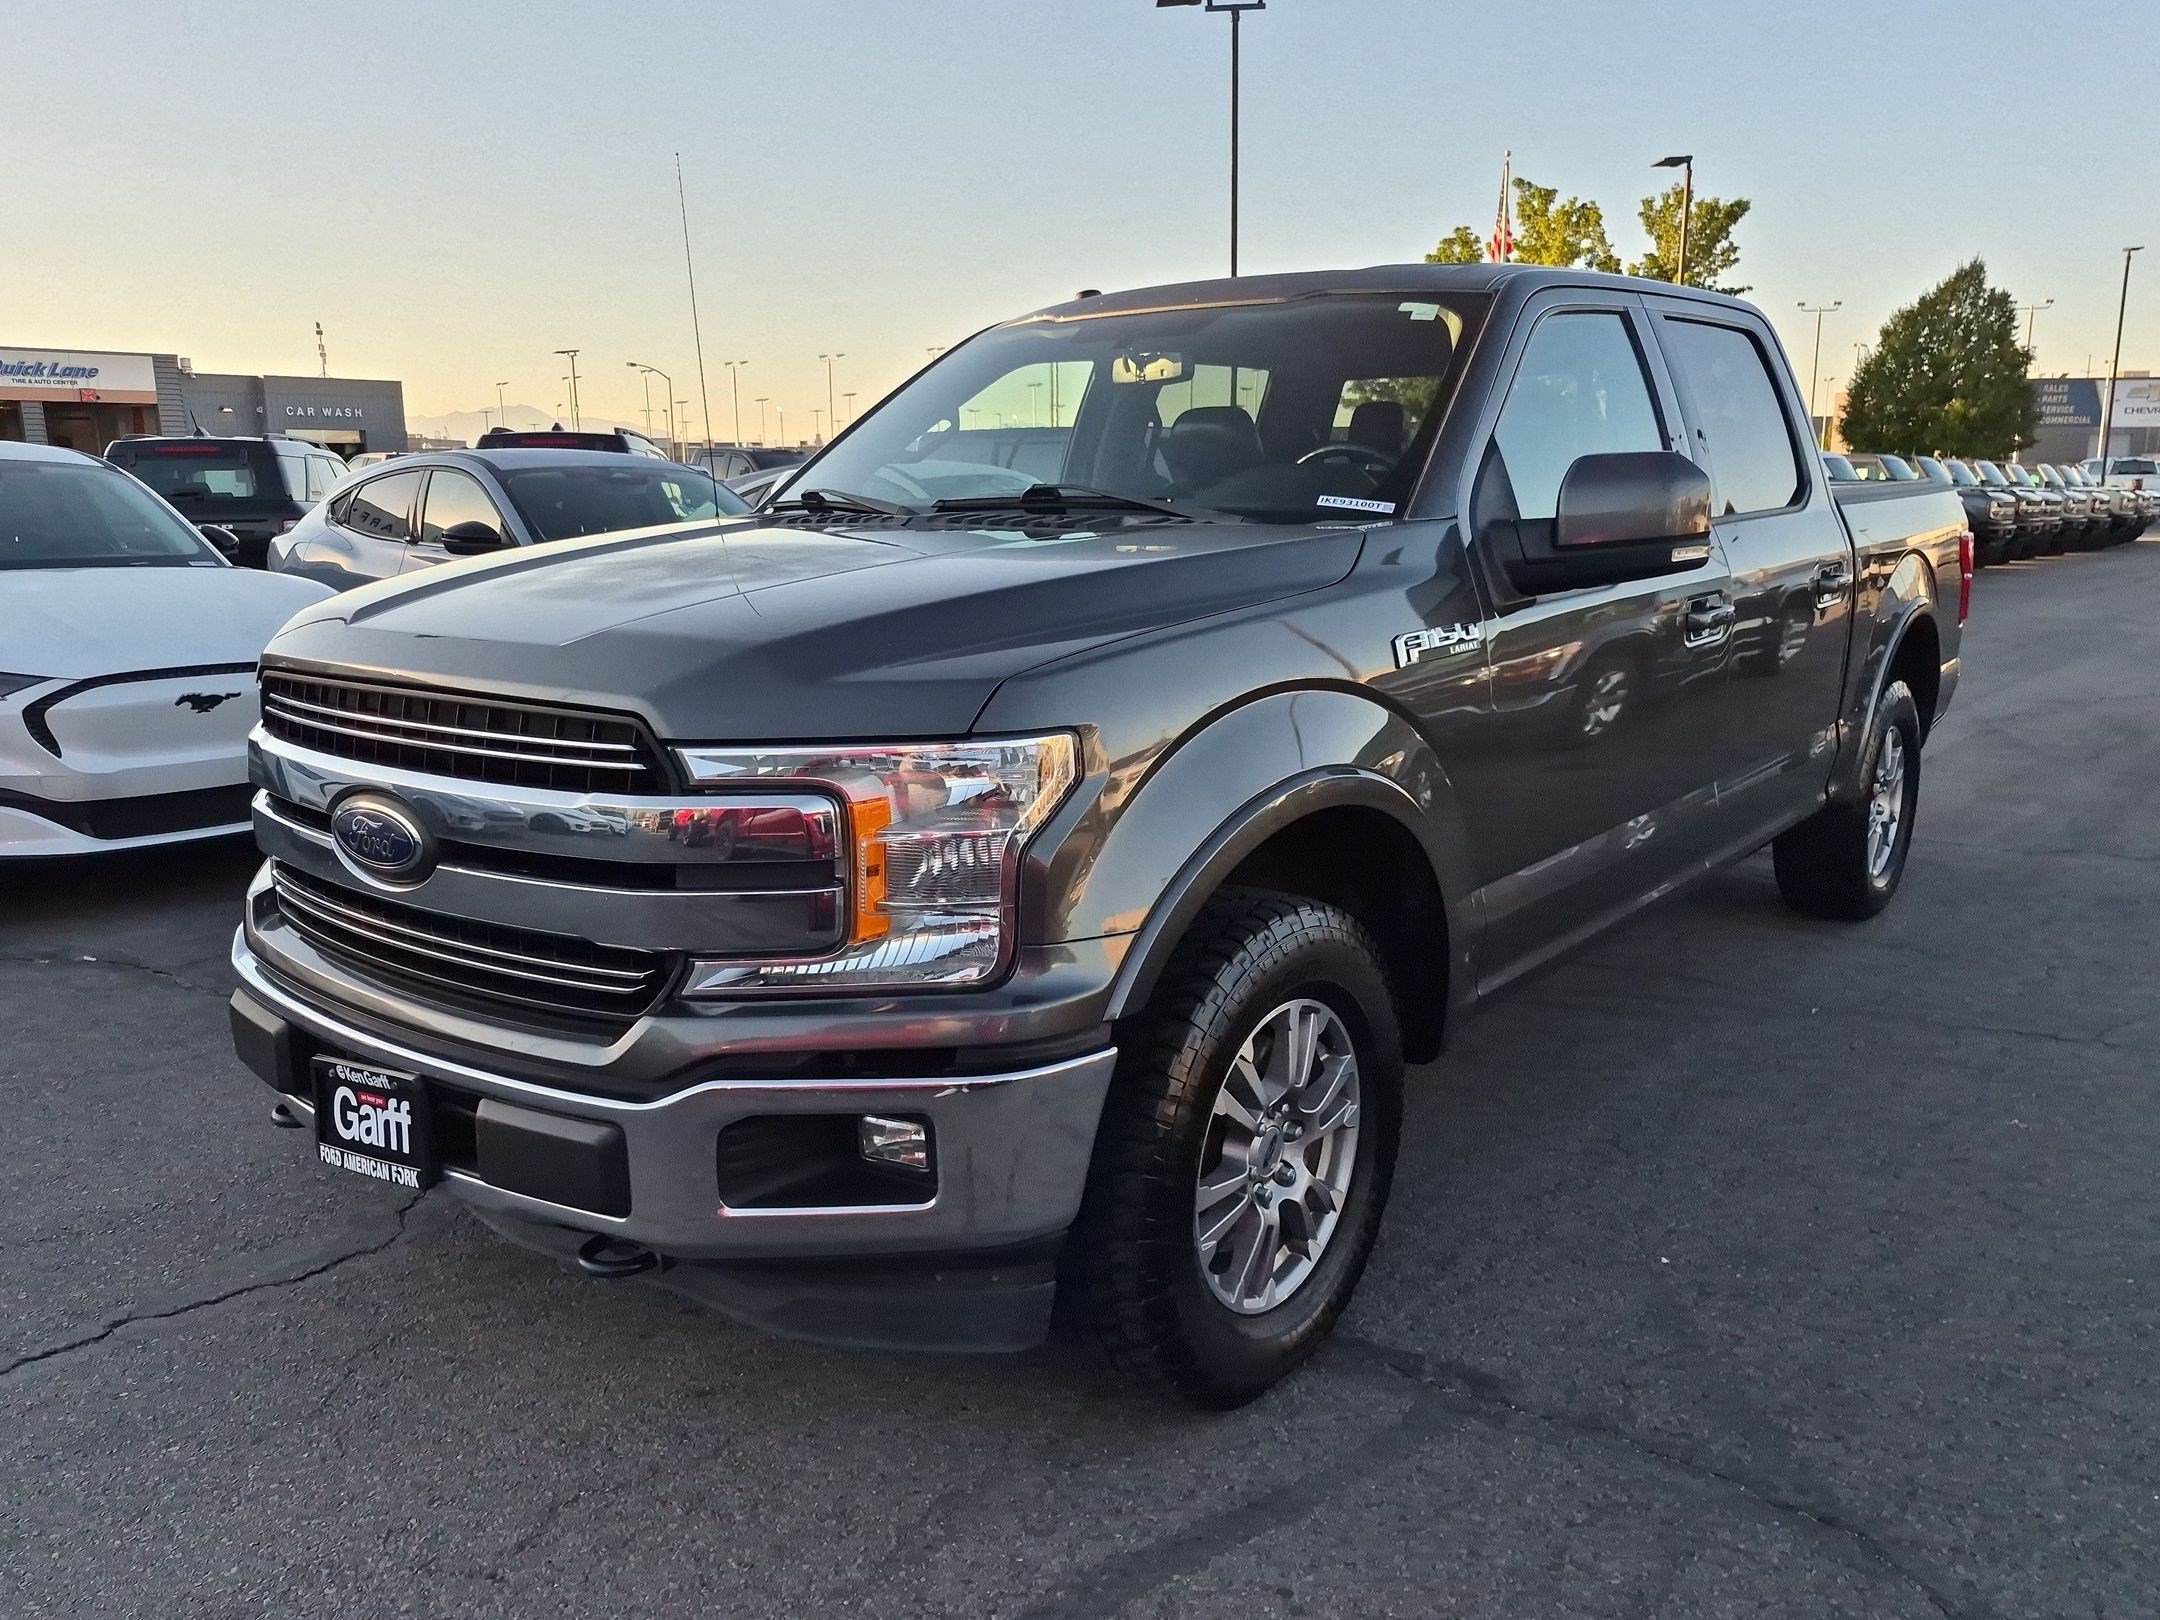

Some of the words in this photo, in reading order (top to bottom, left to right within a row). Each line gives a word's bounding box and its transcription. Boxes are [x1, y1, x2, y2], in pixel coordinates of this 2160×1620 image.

[0, 361, 46, 376] uick
[47, 362, 99, 378] Lane
[2042, 384, 2069, 393] SALES
[2041, 394, 2068, 403] PARTS
[286, 406, 315, 417] CAR
[322, 407, 363, 418] WASH
[2040, 415, 2091, 425] COMMERCIAL
[1450, 641, 1479, 654] LARIAT
[348, 815, 409, 857] Ford
[333, 1085, 412, 1154] Garff
[319, 1144, 342, 1167] FORD
[343, 1154, 390, 1182] AMERICAN
[391, 1166, 420, 1189] FORK
